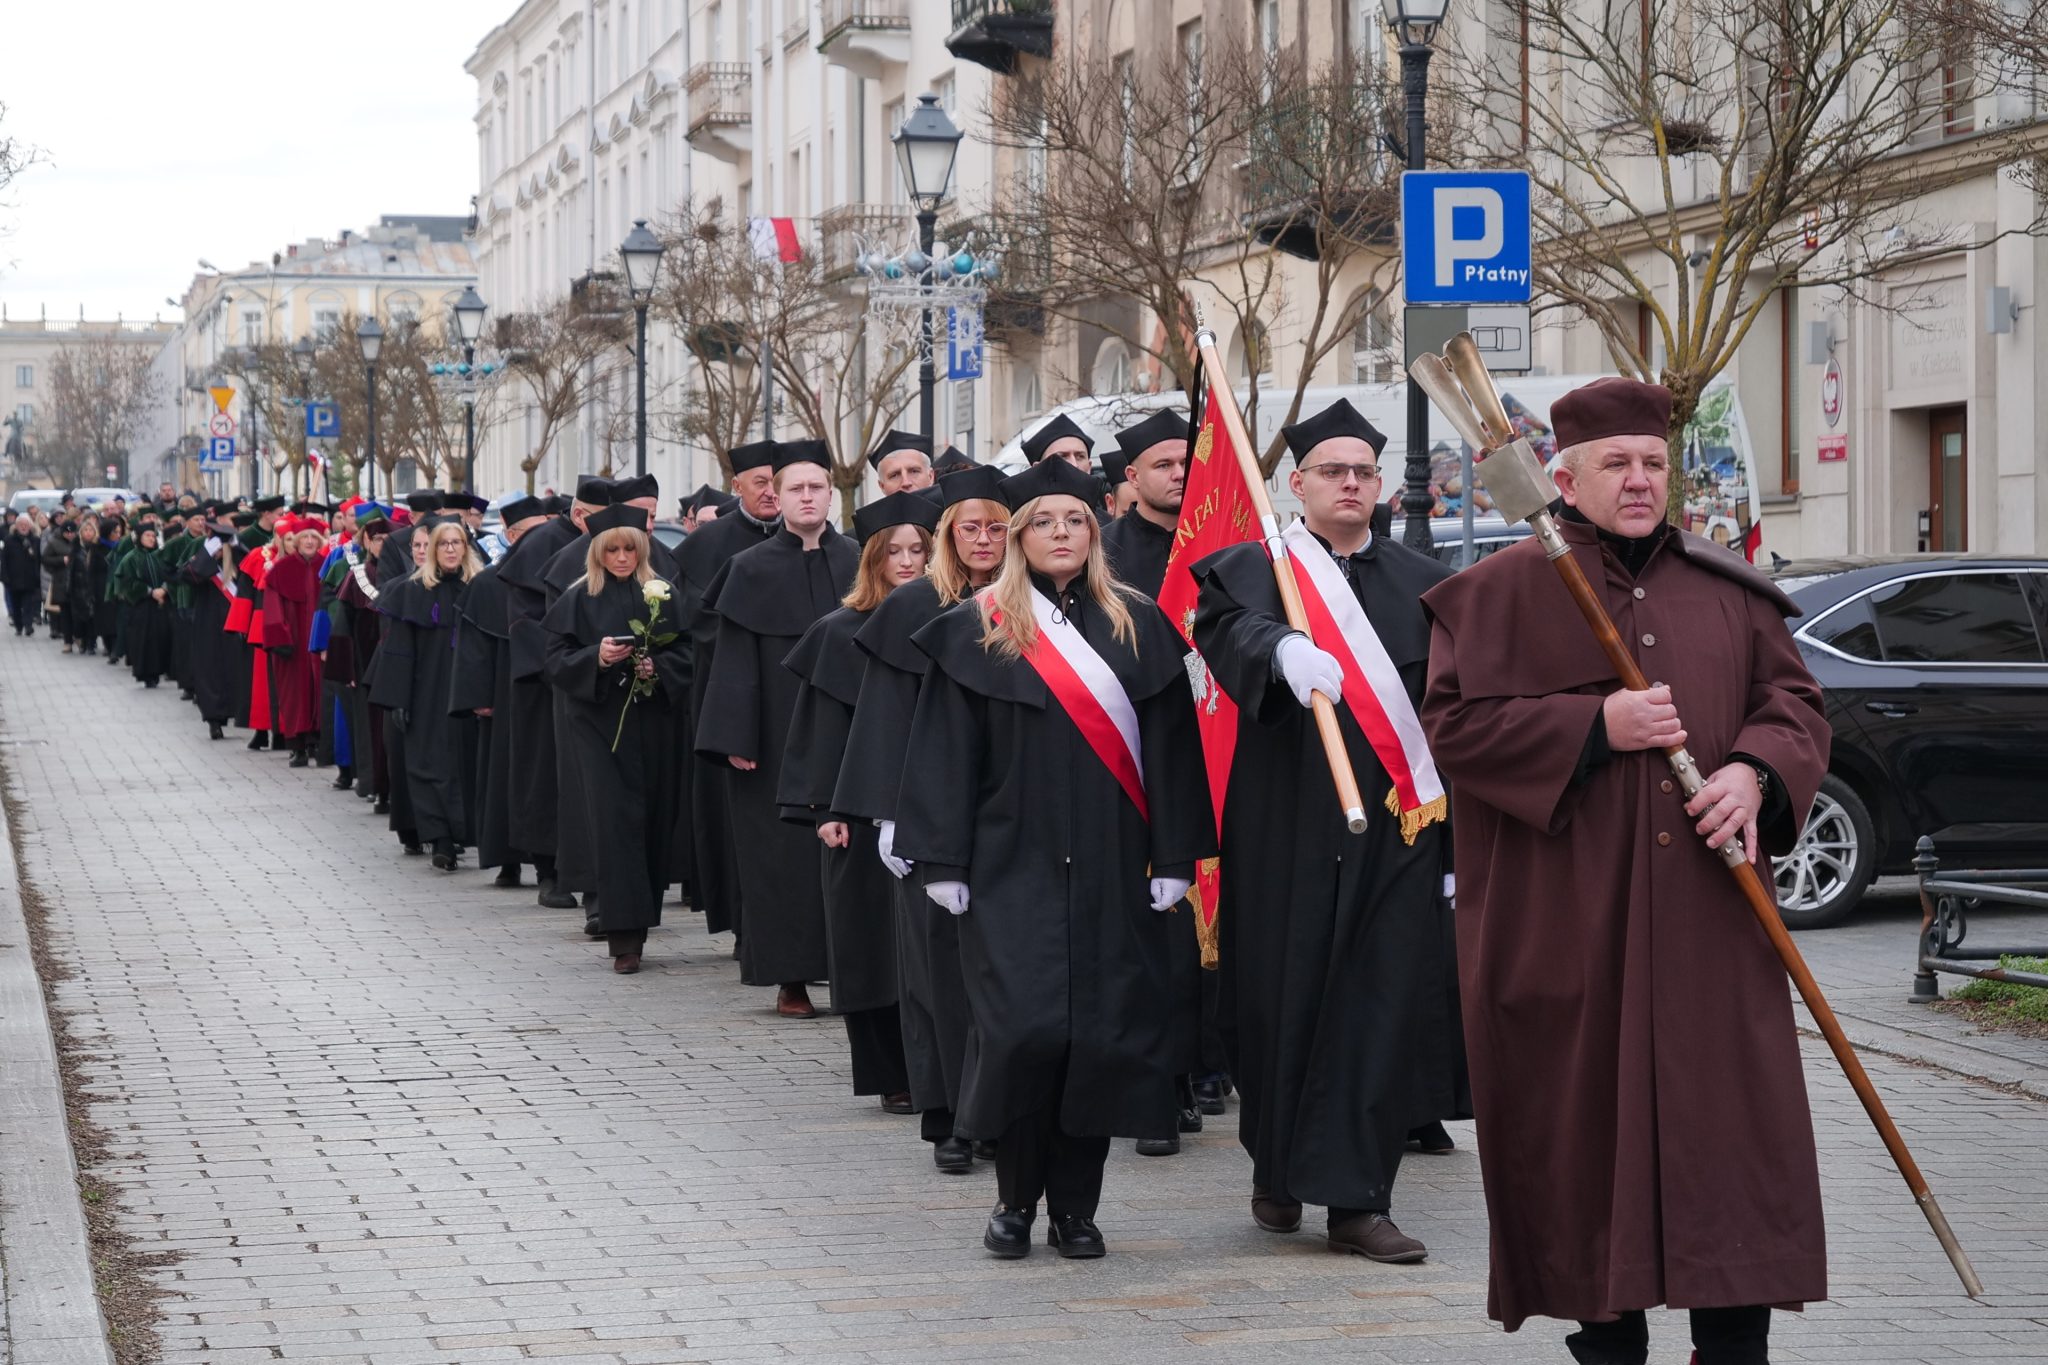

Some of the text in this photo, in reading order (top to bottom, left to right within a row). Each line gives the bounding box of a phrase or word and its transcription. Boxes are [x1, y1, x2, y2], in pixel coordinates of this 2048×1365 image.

[1433, 187, 1504, 287] P
[1465, 265, 1528, 286] Płatny
[313, 406, 333, 433] P
[215, 439, 231, 460] P
